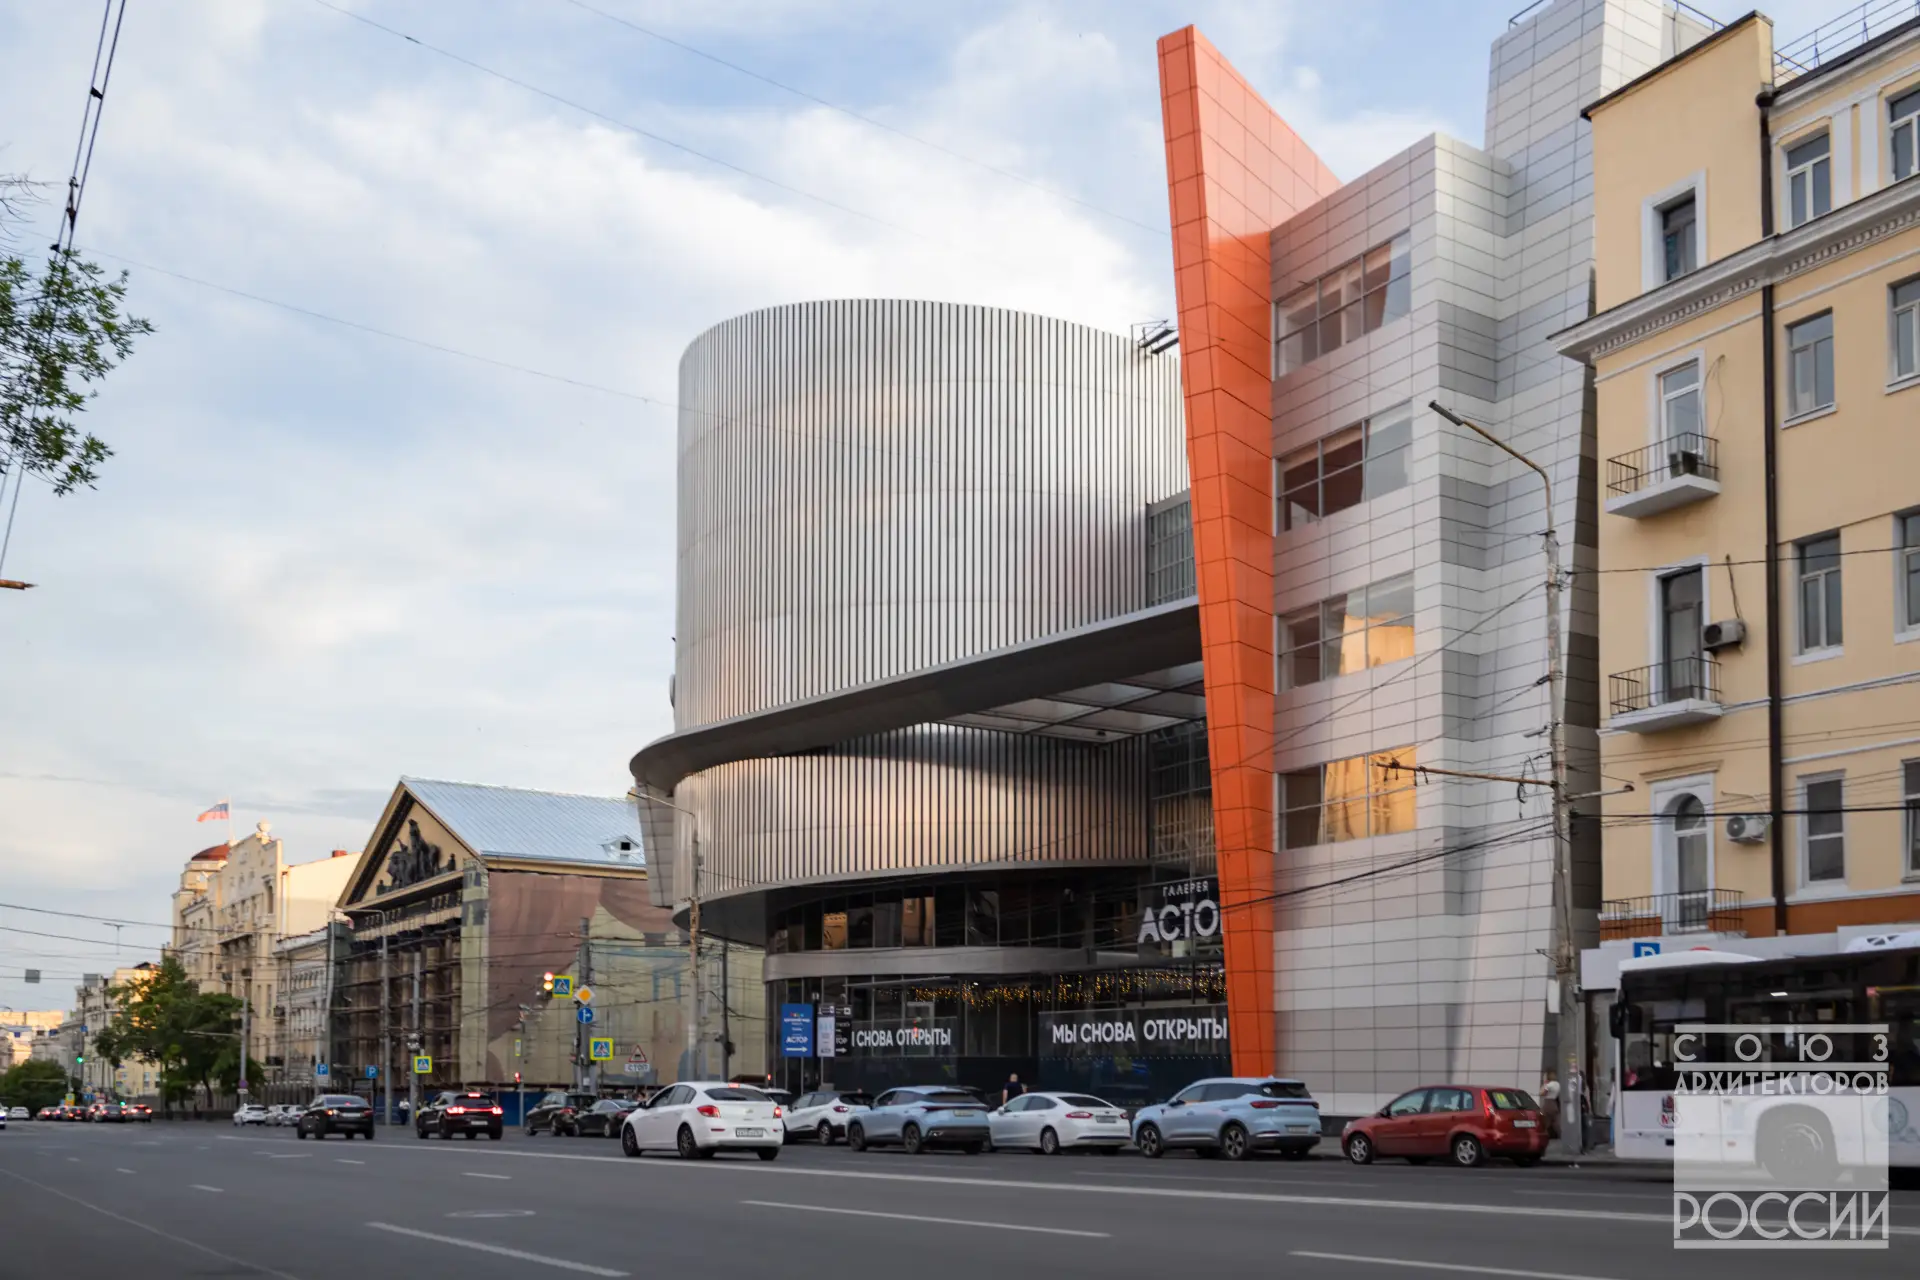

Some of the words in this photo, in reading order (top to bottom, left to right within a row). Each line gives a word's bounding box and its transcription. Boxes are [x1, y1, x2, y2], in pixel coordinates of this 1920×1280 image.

[1162, 881, 1209, 897] ГАЛЕРЕЯ
[1137, 899, 1224, 943] АСТО
[856, 1029, 894, 1047] СНОВА
[896, 1027, 951, 1046] ОТКРЫТЫ
[1052, 1024, 1077, 1044] МЫ
[1080, 1021, 1136, 1043] СНОВА
[1143, 1018, 1227, 1040] ОТКРЫТЫ
